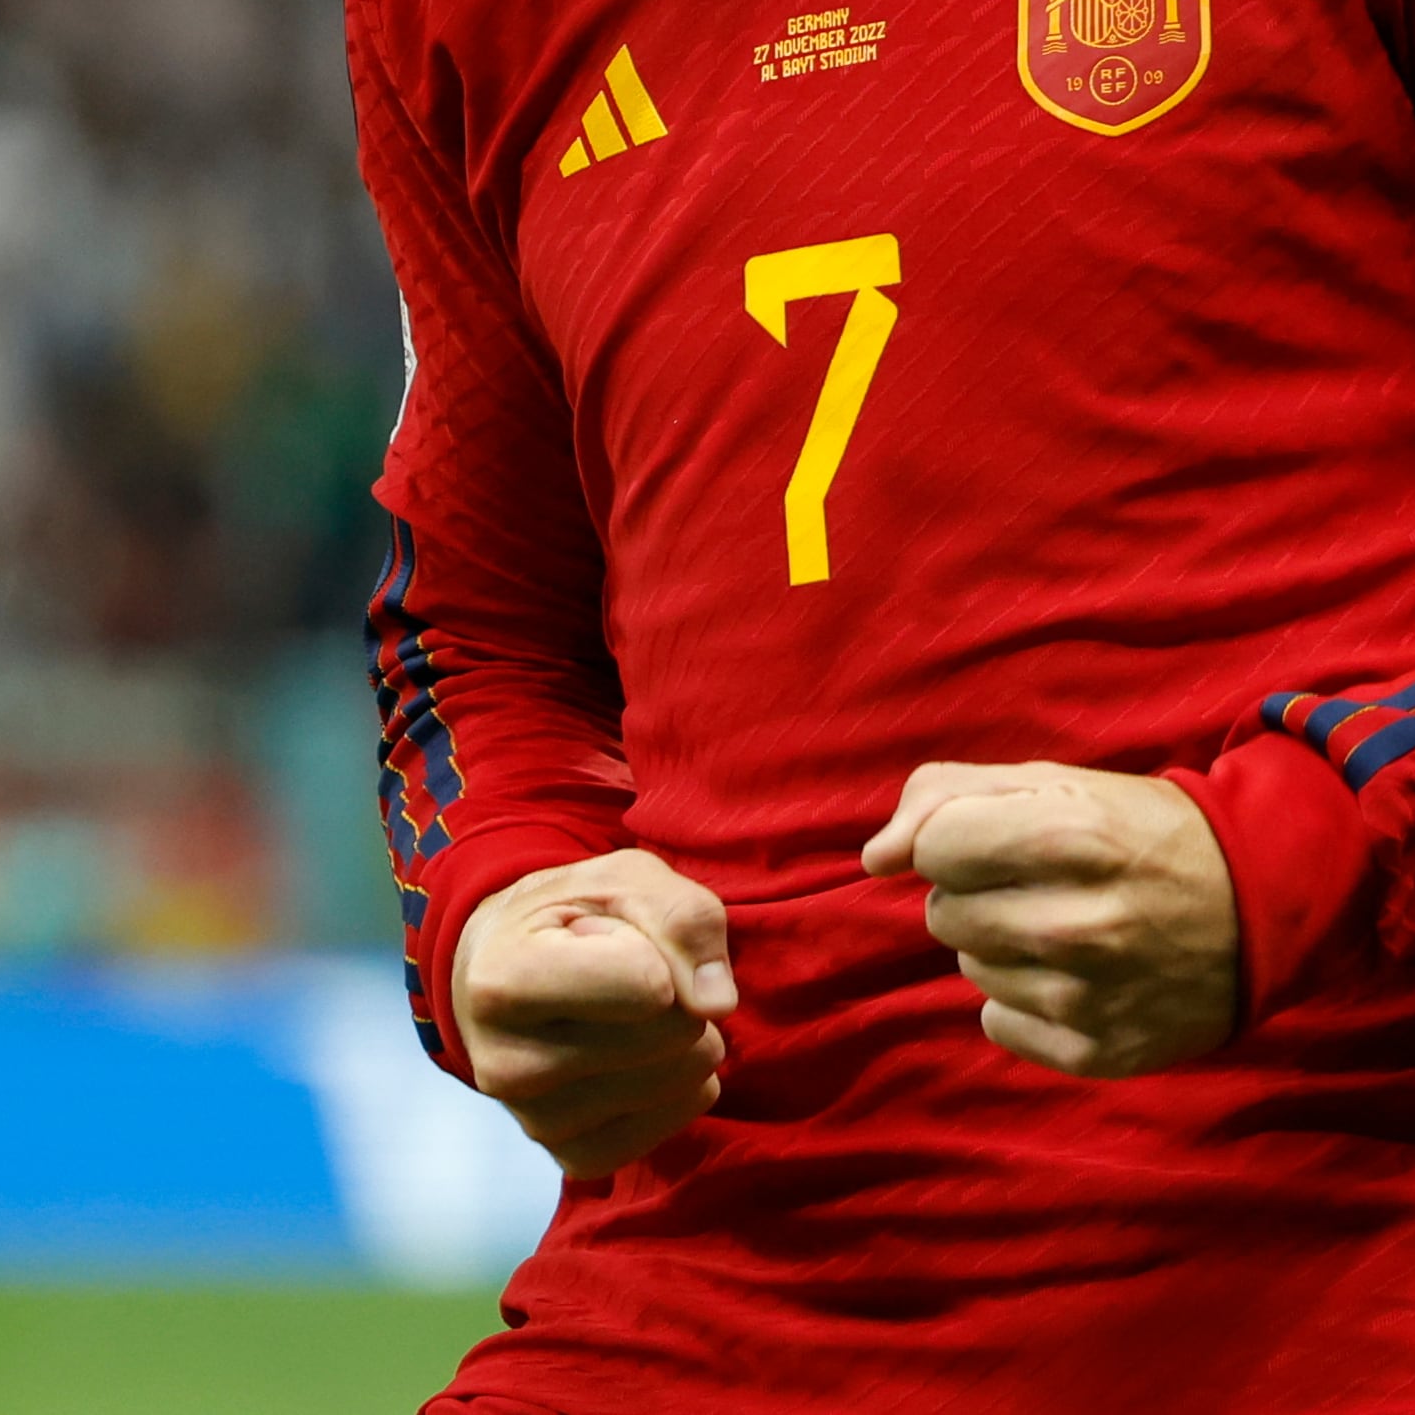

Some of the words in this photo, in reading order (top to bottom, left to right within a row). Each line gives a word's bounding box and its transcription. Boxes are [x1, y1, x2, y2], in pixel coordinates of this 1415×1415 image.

[787, 7, 850, 36] GERMANY
[753, 44, 769, 65] 27
[775, 29, 845, 59] NOVEMBER
[849, 21, 887, 44] 2022
[761, 64, 778, 83] AL
[782, 55, 816, 78] BAYT
[820, 43, 877, 70] STADIUM
[1066, 76, 1083, 91] 19
[1143, 70, 1164, 85] 09
[745, 233, 902, 586] 7
